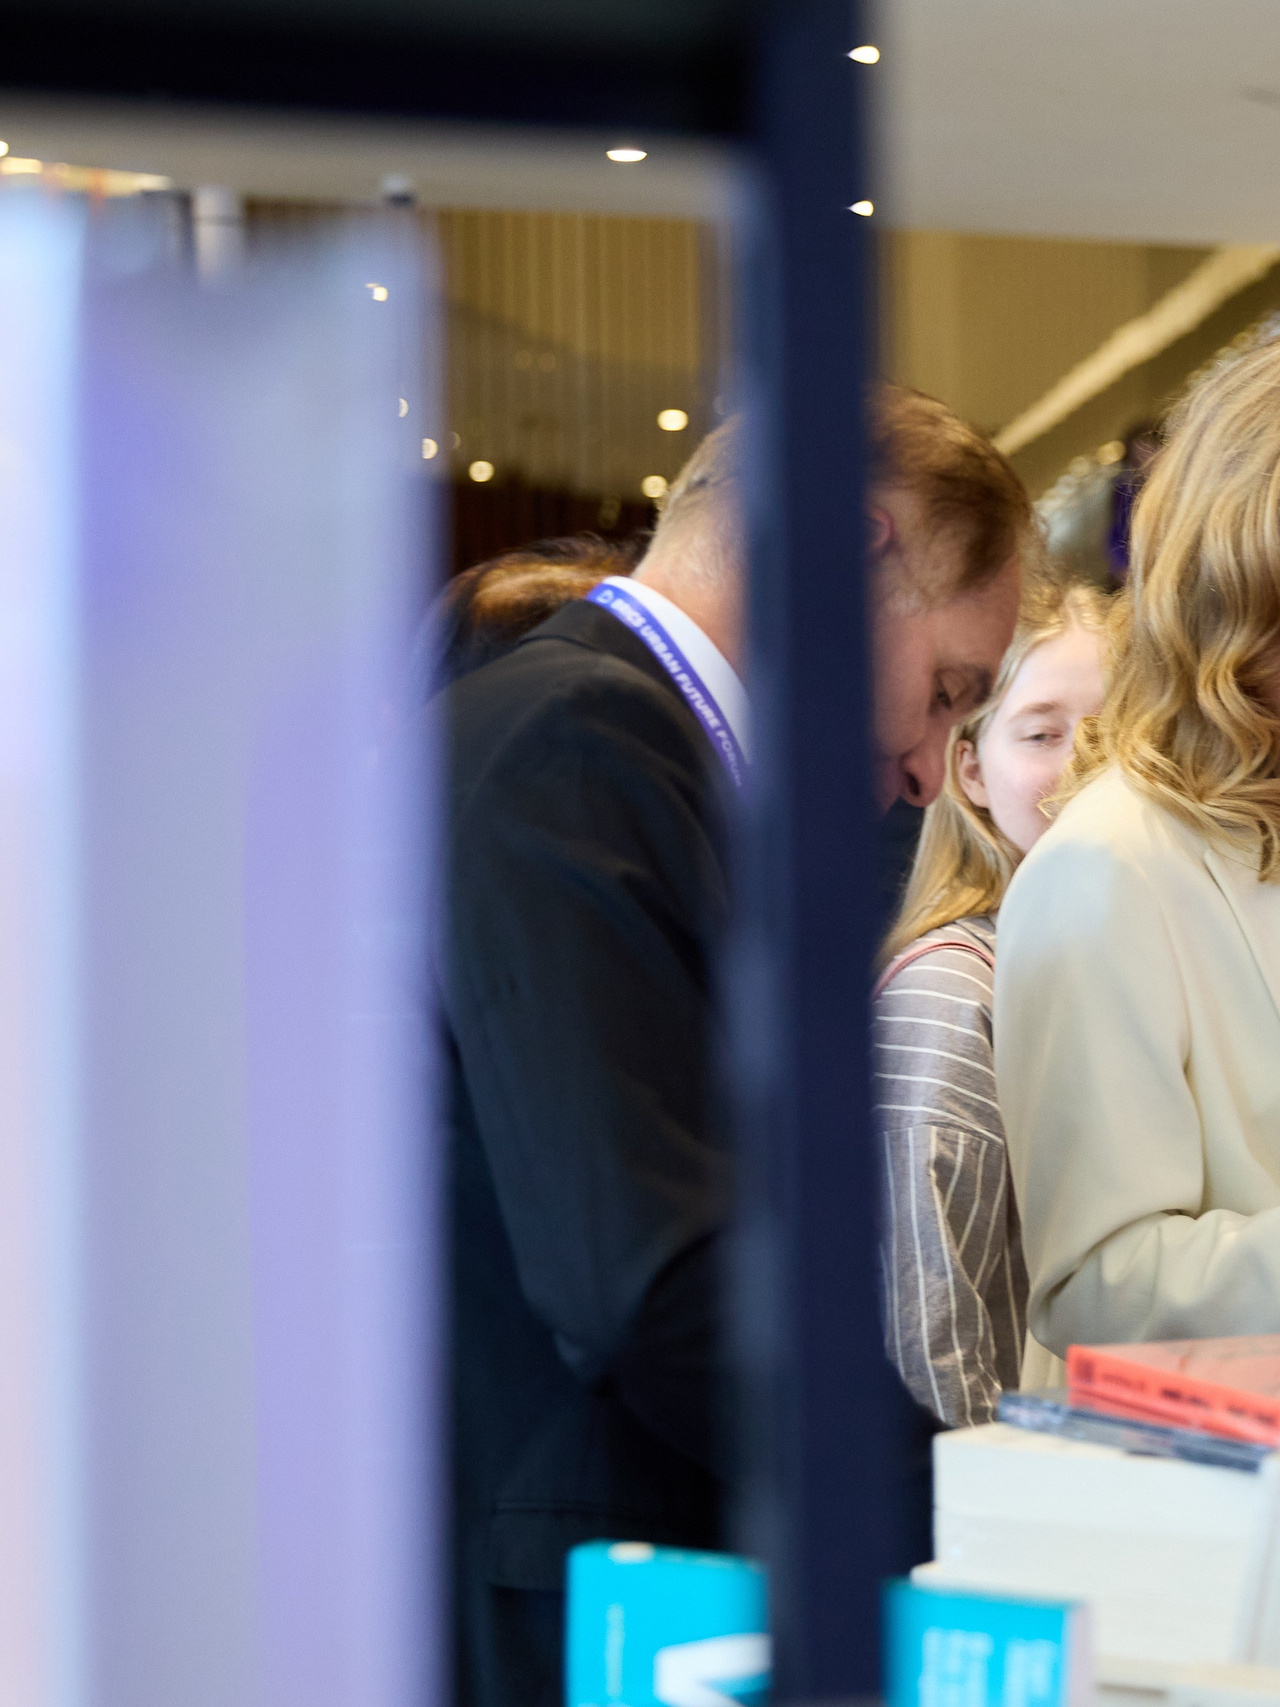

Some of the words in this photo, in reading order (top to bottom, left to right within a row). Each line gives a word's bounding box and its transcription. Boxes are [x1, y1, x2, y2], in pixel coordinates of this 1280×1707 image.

[610, 597, 647, 628] BRICS
[639, 624, 682, 674] URBAN
[674, 672, 721, 730] FUTURE
